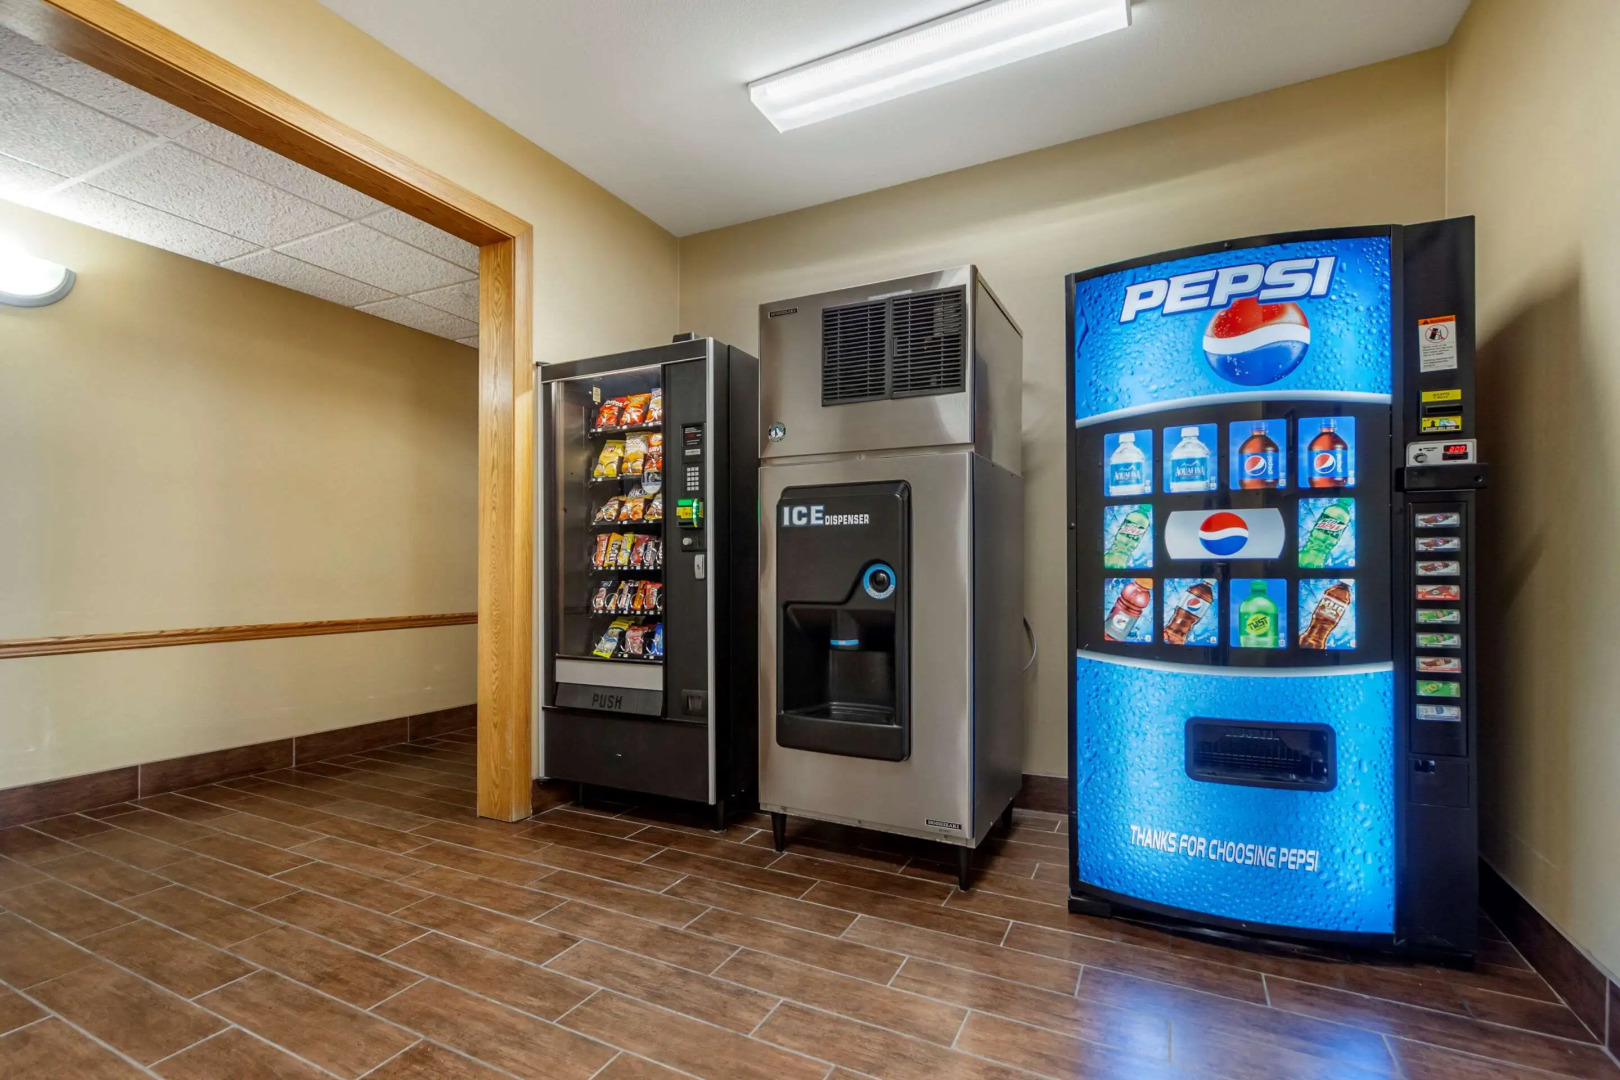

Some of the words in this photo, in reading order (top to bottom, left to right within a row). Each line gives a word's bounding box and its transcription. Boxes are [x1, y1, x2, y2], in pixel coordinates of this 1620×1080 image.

[1119, 256, 1336, 323] PEPSI
[1175, 466, 1205, 477] AQUAFINA
[782, 504, 824, 527] ICE
[824, 513, 870, 526] DISPENSER
[1320, 598, 1346, 615] MUG
[1247, 616, 1269, 631] TWIST
[591, 693, 623, 709] PUSH
[1130, 824, 1177, 853] THANKS
[1178, 834, 1206, 859] FOR
[1208, 839, 1276, 868] CHOOSING
[1278, 847, 1319, 873] PEPSI
